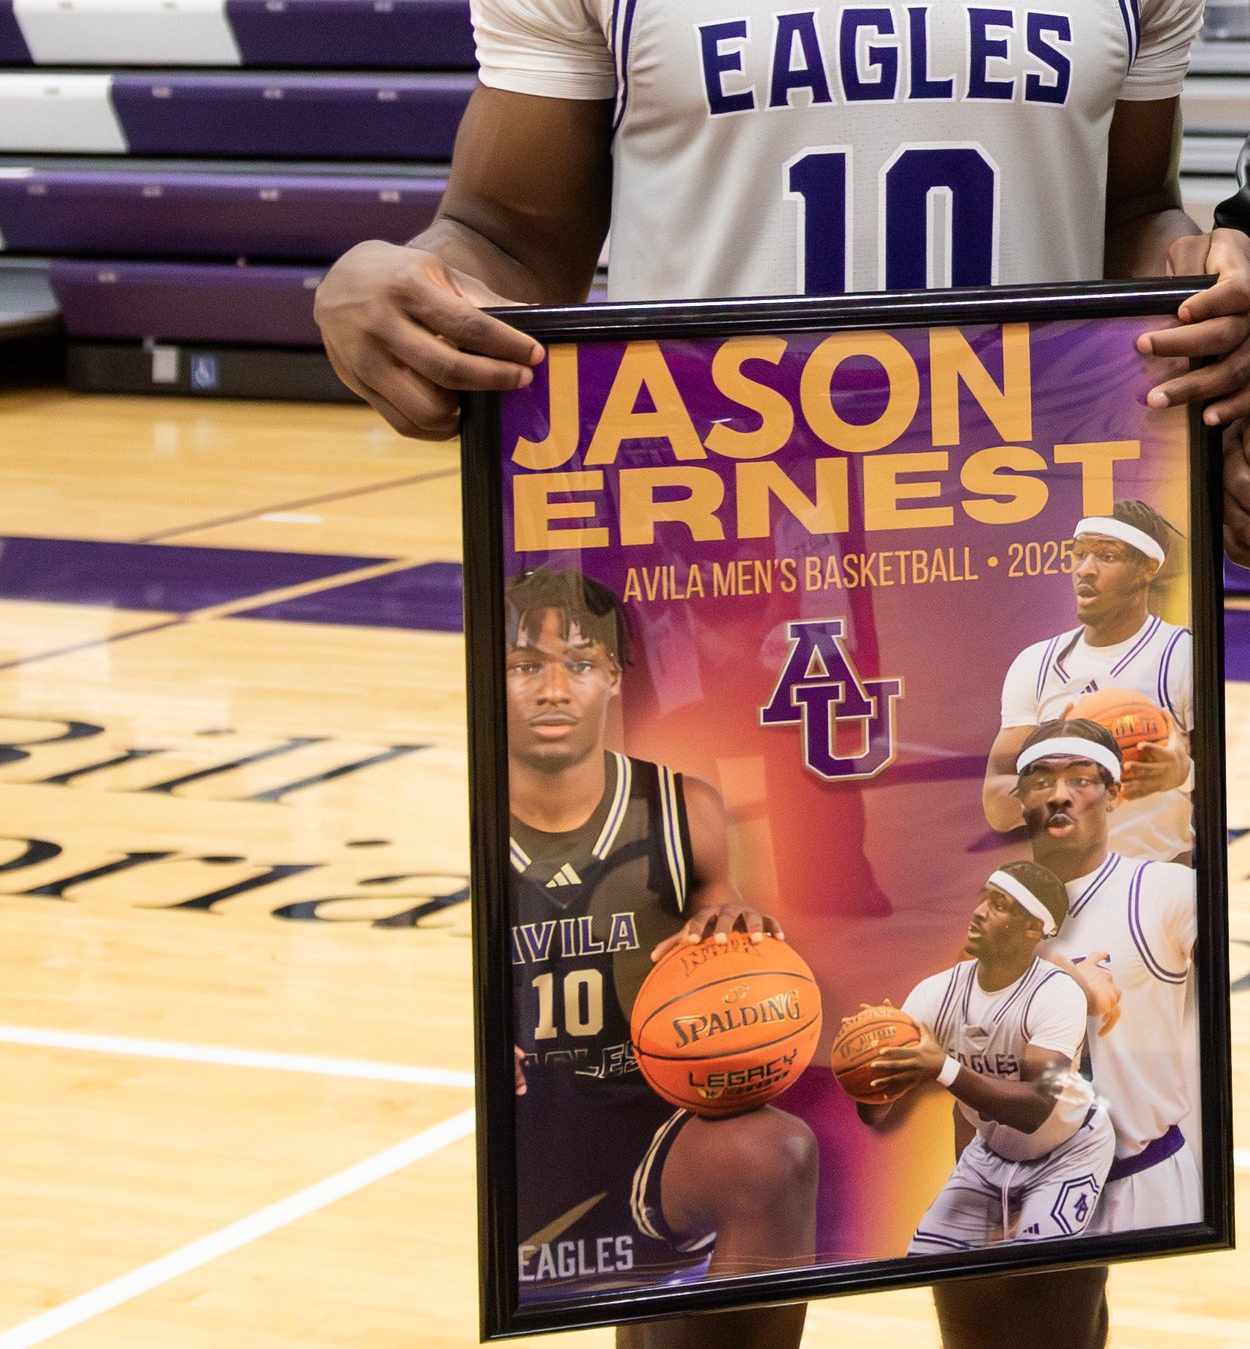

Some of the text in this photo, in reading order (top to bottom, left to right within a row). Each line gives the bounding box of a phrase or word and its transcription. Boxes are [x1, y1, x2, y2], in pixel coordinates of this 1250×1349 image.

[694, 4, 1072, 118] EAGLES
[782, 142, 1000, 294] 10
[511, 321, 1033, 471] JASON
[512, 440, 1141, 553] ERNEST
[623, 540, 1075, 603] AVILA MEN'S BASKETBALL 2025
[531, 968, 604, 1040] 10
[672, 990, 801, 1049] SPALDING
[688, 1048, 798, 1088] LEGACY
[518, 1235, 634, 1281] EAGLES
